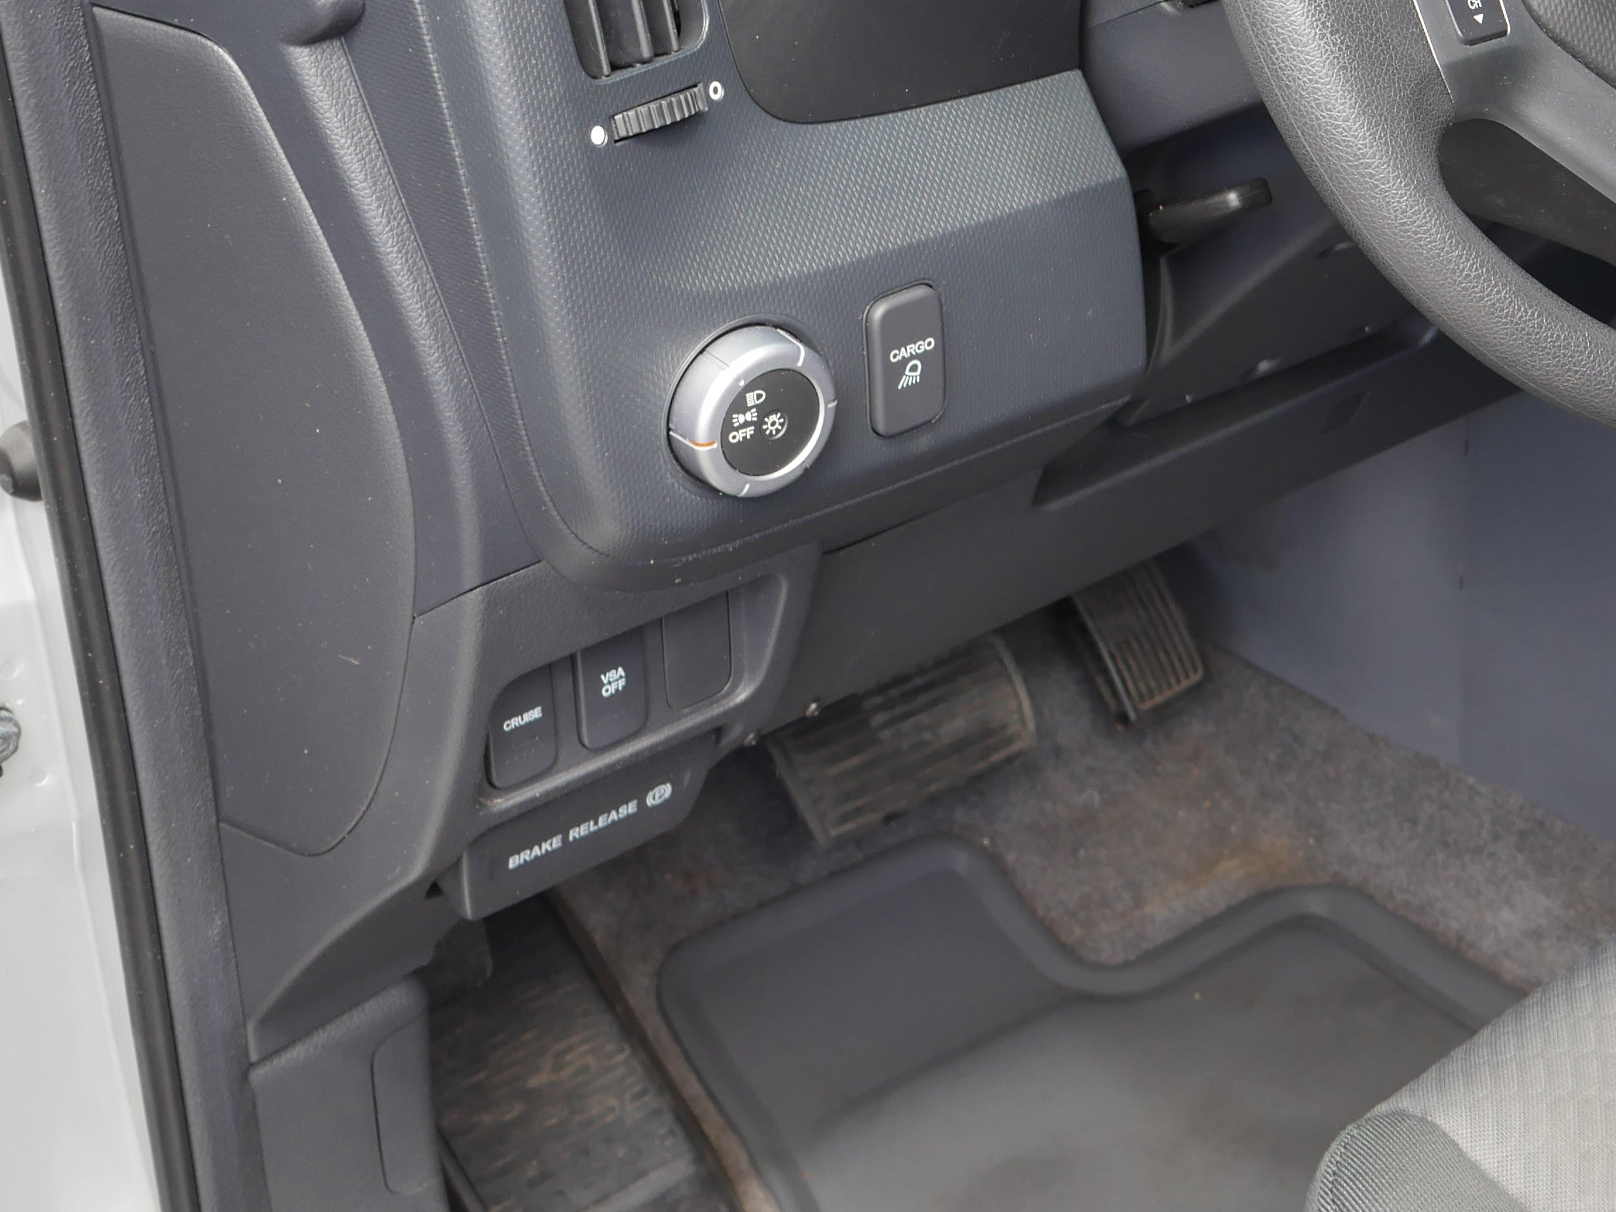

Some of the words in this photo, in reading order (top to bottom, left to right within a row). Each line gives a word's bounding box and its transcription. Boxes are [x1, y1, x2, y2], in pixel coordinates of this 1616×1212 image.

[889, 337, 935, 363] CARGO
[728, 426, 755, 444] OFF
[600, 666, 626, 684] VSA
[601, 678, 627, 698] OFF
[503, 706, 543, 732] CRUISE
[508, 833, 563, 871] BRAKE
[568, 799, 639, 843] RELEASE
